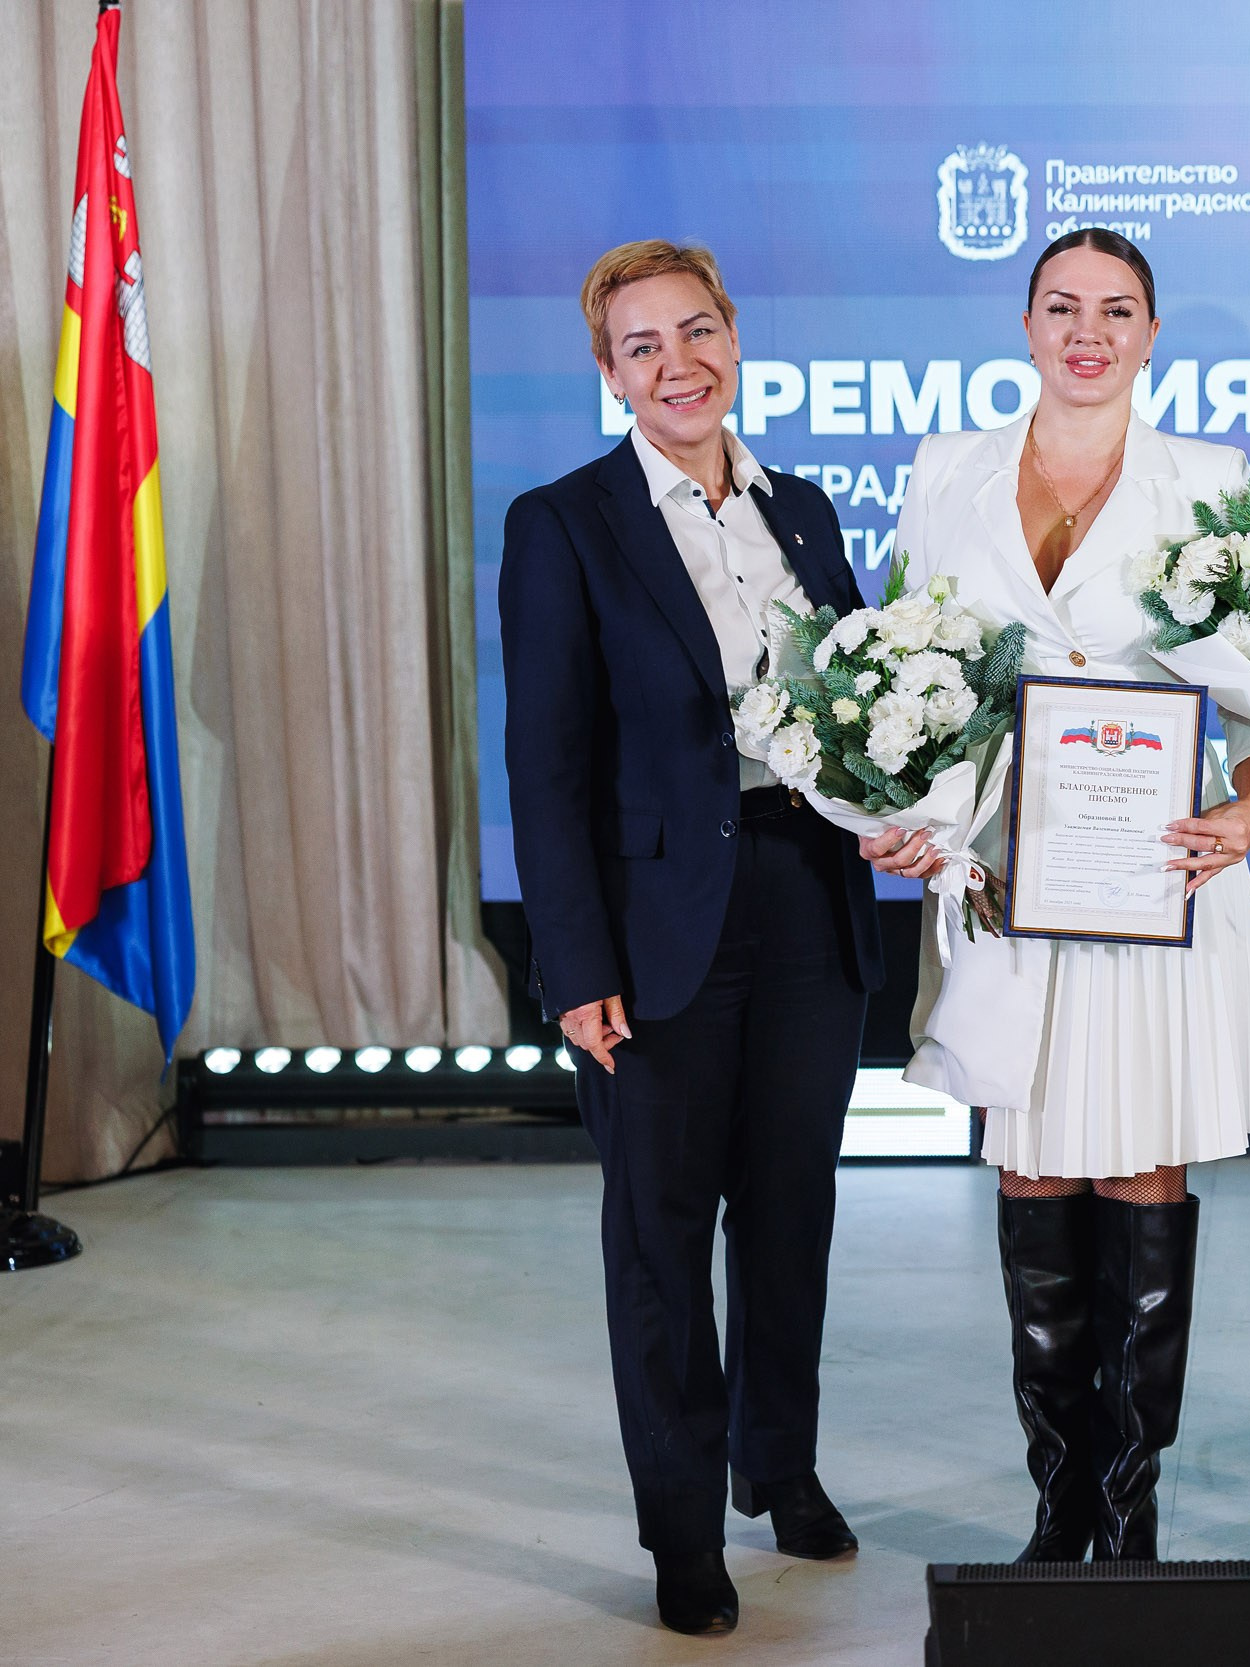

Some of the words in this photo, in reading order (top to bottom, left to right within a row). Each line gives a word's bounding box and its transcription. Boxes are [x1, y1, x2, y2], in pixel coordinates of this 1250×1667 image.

[1046, 159, 1238, 191] Правительство
[1059, 782, 1159, 796] БЛАГОДАРСТВЕННОЕ
[1088, 794, 1128, 804] ПИСЬМО
